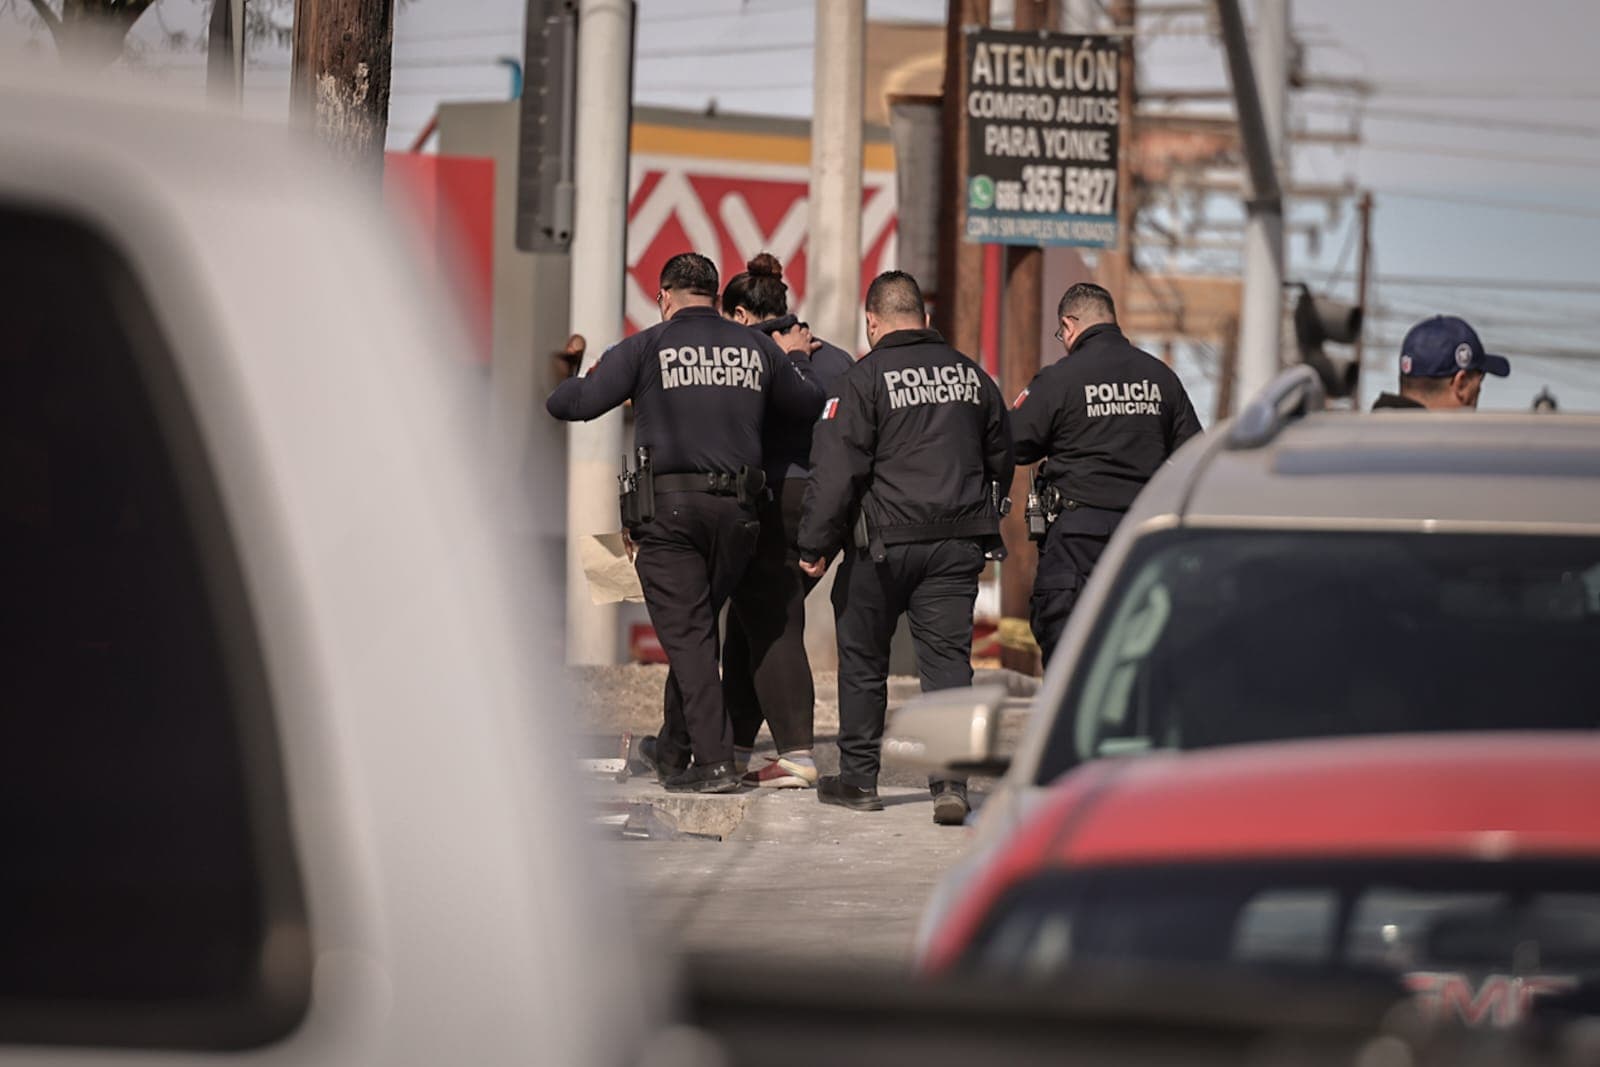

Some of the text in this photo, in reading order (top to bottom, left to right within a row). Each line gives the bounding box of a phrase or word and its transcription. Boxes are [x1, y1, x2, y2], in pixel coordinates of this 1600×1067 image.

[972, 39, 1117, 91] ATENCIÓN
[968, 90, 1119, 125] COMPRO AUTOS
[985, 124, 1110, 161] PARA YONKE
[1022, 165, 1062, 212] 355
[659, 346, 763, 373] POLICIA
[661, 366, 762, 392] MUNICIPAL
[883, 363, 981, 391] POLICÍA
[889, 384, 981, 409] MUNICIPAL
[1085, 379, 1162, 403] POLICÍA
[1087, 401, 1162, 418] MUNICIPAL
